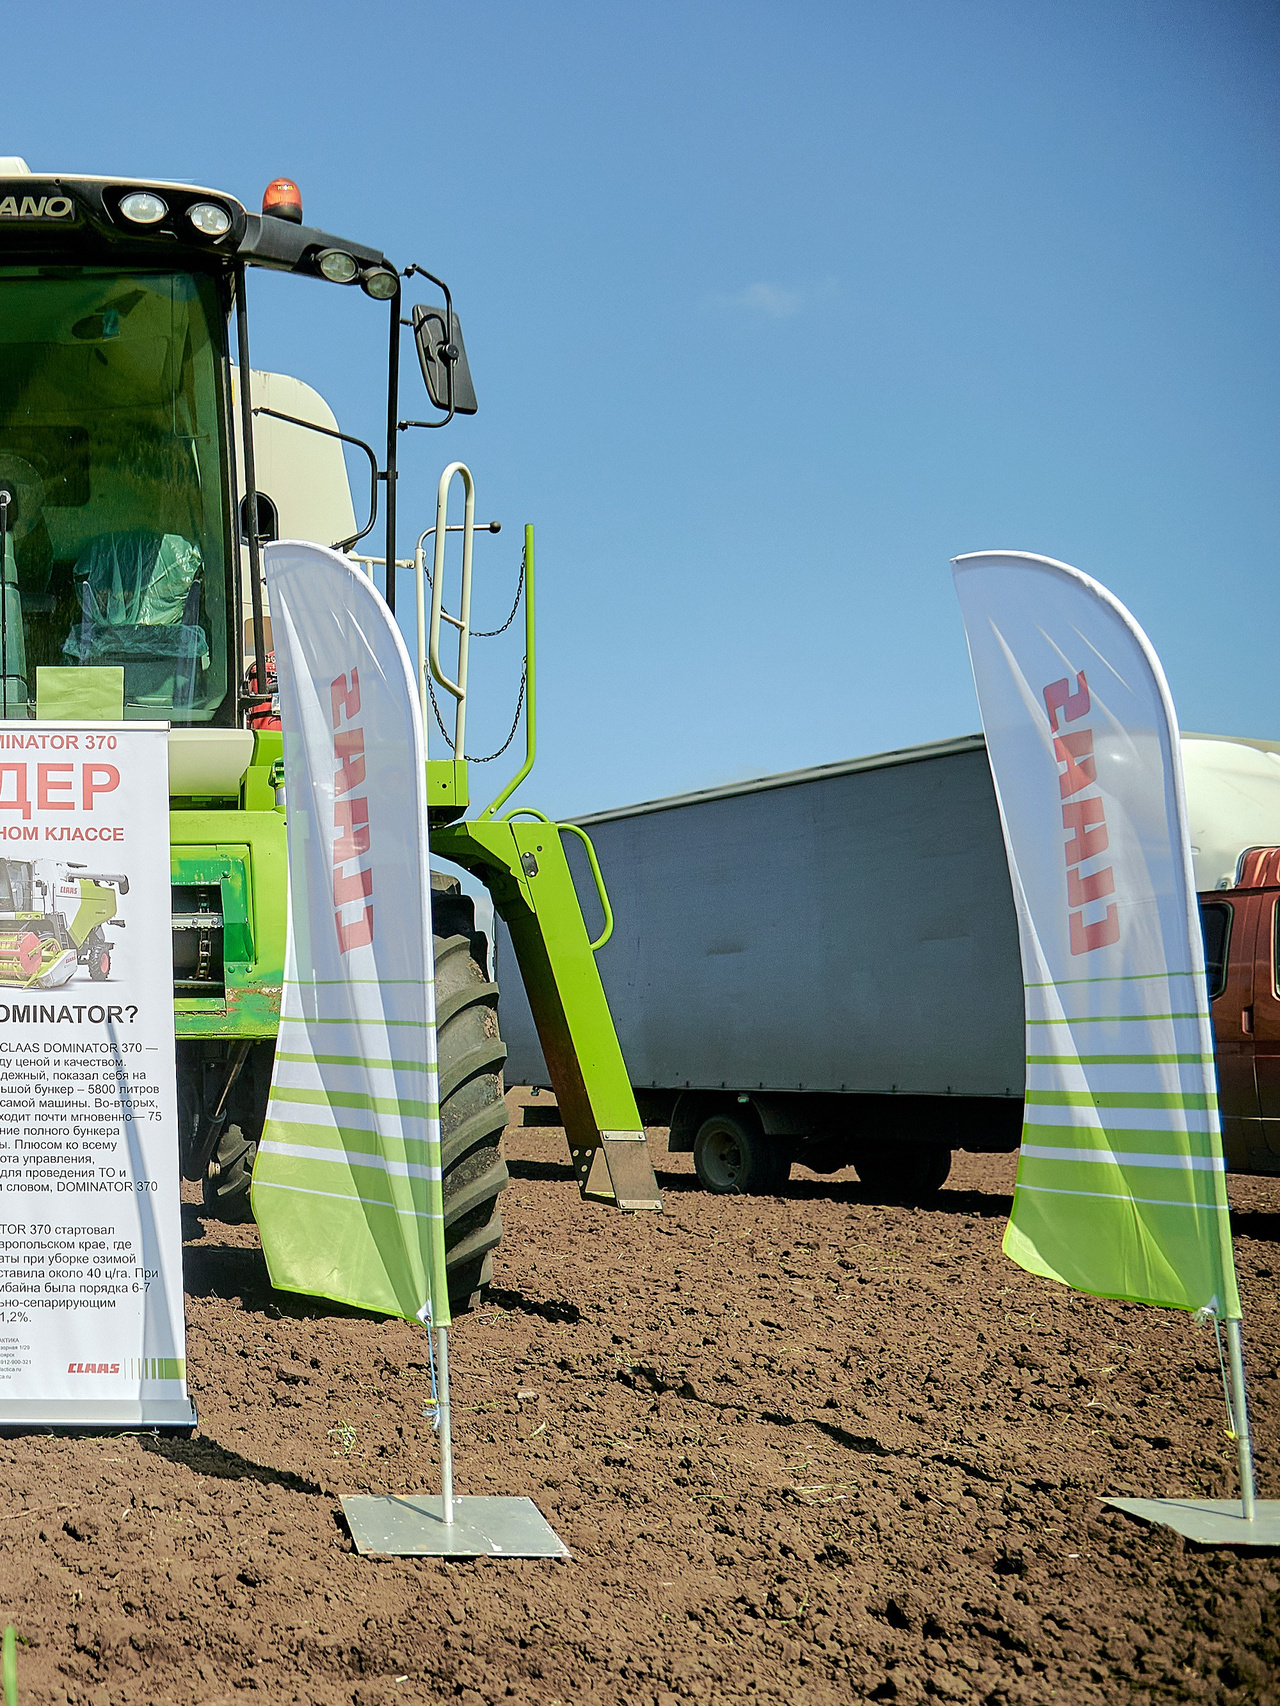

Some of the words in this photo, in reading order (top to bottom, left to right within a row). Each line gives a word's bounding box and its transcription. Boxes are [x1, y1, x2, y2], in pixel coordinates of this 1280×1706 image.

[85, 734, 117, 750] 370
[45, 827, 124, 841] КЛАССЕ
[60, 886, 78, 895] CLAAS
[0, 1042, 40, 1053] CLAAS
[43, 1042, 119, 1054] DOMINATOR
[121, 1042, 143, 1053] 370
[15, 1056, 50, 1068] ценой
[53, 1059, 61, 1067] и
[63, 1058, 127, 1067] качеством.
[52, 1072, 99, 1081] показал
[102, 1069, 129, 1081] себя
[132, 1071, 147, 1080] на
[34, 1083, 75, 1097] бункер
[87, 1083, 116, 1095] 5800
[119, 1085, 160, 1096] литров
[0, 1097, 36, 1108] самой
[38, 1099, 91, 1108] машины.
[94, 1097, 158, 1110] Во-вторых,
[34, 1113, 67, 1122] почти
[148, 1111, 162, 1122] 75
[23, 1127, 70, 1136] полного
[73, 1125, 120, 1139] бункера
[14, 1138, 63, 1150] Плюсом
[65, 1141, 79, 1150] ко
[82, 1141, 118, 1153] всему
[22, 1155, 95, 1167] управления,
[0, 1169, 22, 1179] для
[25, 1169, 95, 1180] проведения
[98, 1167, 116, 1178] ТО
[119, 1169, 127, 1178] и
[6, 1183, 53, 1193] словом,
[56, 1181, 134, 1193] DOMINATOR
[136, 1180, 158, 1192] 370
[29, 1223, 52, 1235] 370
[54, 1226, 115, 1238] стартовал
[78, 1240, 109, 1252] крае,
[113, 1240, 132, 1251] где
[23, 1255, 45, 1266] при
[47, 1252, 90, 1267] уборке
[92, 1253, 137, 1264] озимой
[48, 1269, 84, 1279] около
[86, 1267, 102, 1279] 40
[104, 1267, 131, 1280] ц/га.
[135, 1267, 159, 1281] При
[44, 1281, 76, 1293] была
[79, 1284, 129, 1296] порядка
[131, 1282, 151, 1294] 6-7
[0, 1311, 32, 1324] 1,2%.
[67, 1363, 120, 1374] CLAAS
